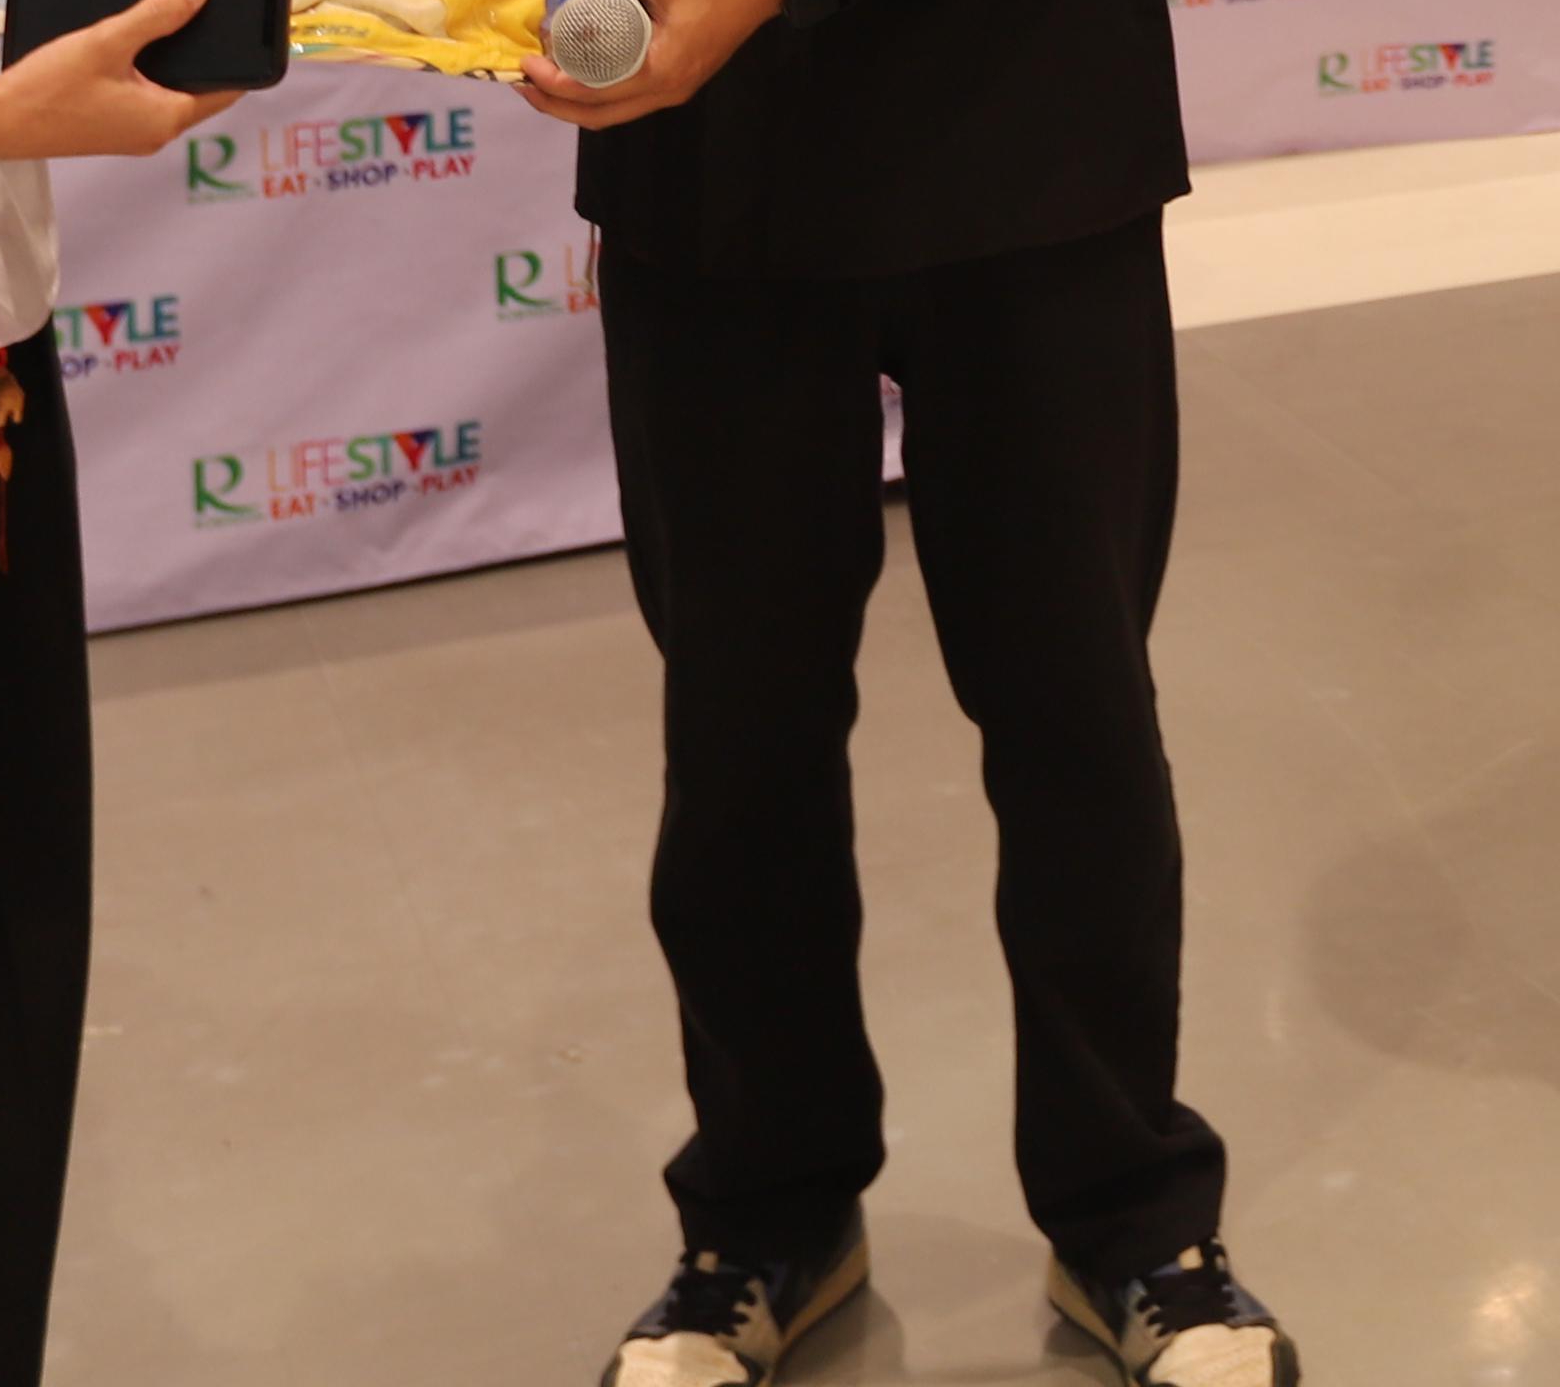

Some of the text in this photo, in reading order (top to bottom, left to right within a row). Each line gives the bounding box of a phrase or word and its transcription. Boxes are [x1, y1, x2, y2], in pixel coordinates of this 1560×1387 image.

[186, 108, 475, 191] R LIFESTYLE
[263, 172, 309, 199] EAT
[328, 164, 398, 191] SHOP
[412, 155, 476, 181] PLAY
[496, 250, 554, 306] R
[113, 342, 182, 373] PLAY
[194, 422, 481, 514] R LIFESTYLE
[335, 481, 406, 512] SHOP
